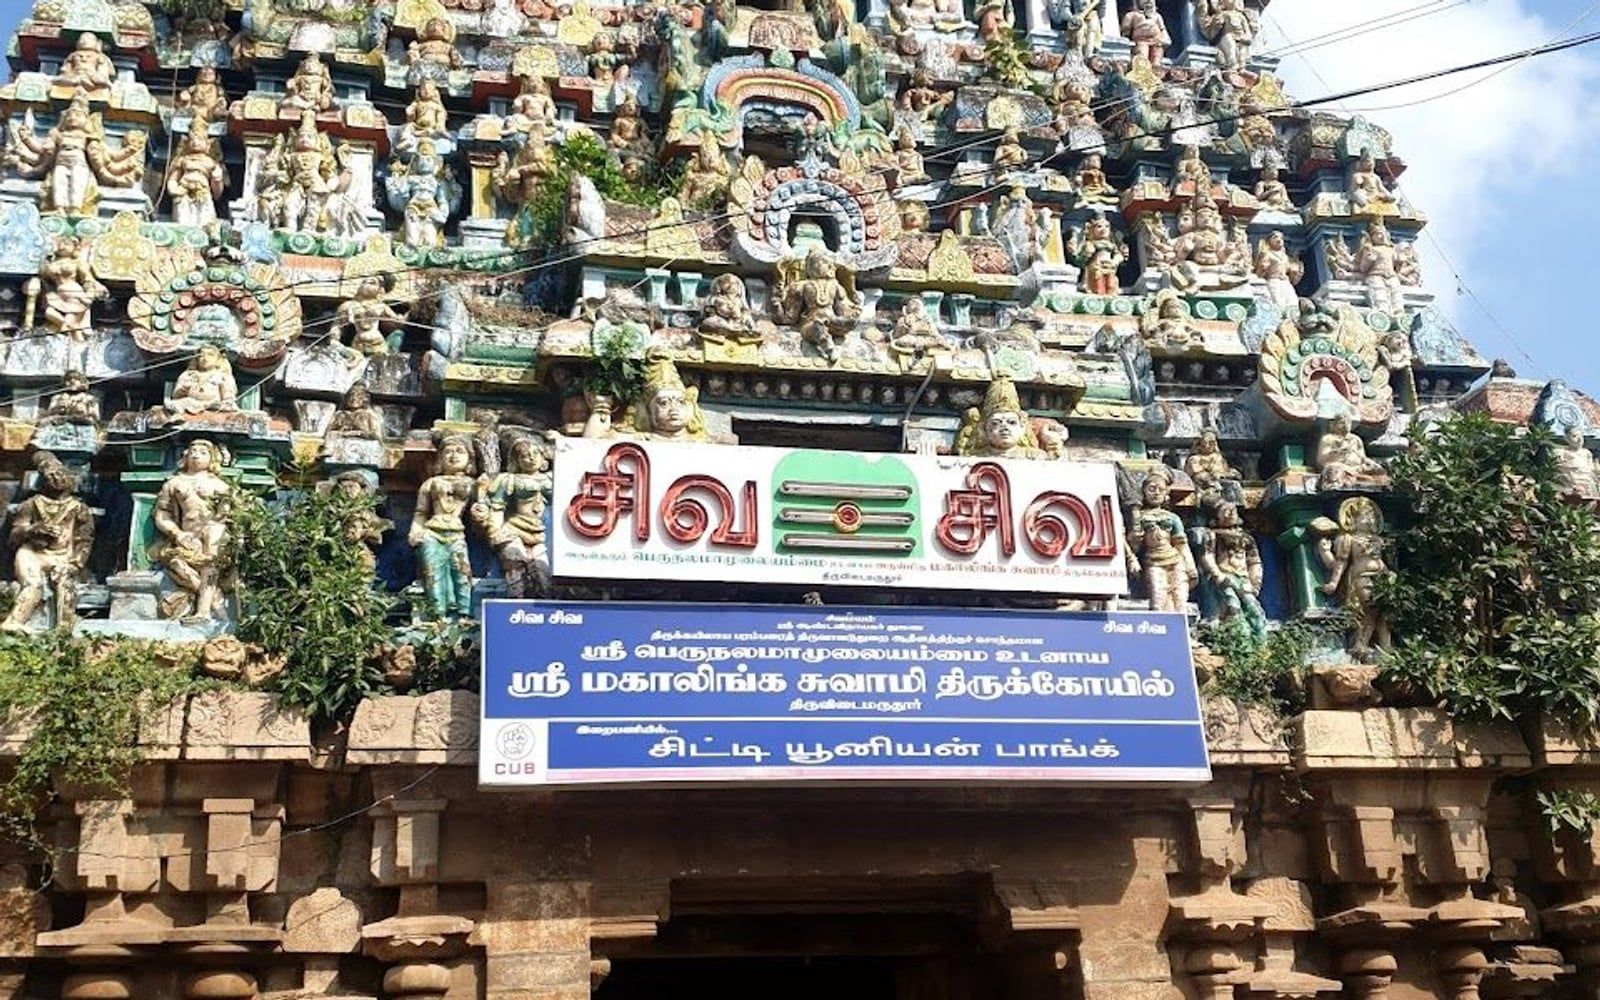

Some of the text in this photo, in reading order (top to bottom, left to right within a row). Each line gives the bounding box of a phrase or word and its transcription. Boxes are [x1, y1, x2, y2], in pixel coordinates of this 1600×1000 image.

[567, 441, 758, 547] சிவ
[936, 461, 1118, 560] சிவ
[930, 561, 1007, 573] மகாலிங்க
[1010, 564, 1061, 575] சுவாமி
[509, 610, 584, 625] சிவ சிவ
[1103, 621, 1167, 635] சிவ சிவ
[634, 643, 987, 662] பெருநலமாமுலையம்மை
[995, 648, 1110, 665] உடனாய
[582, 663, 788, 694] மகாலிங்க
[796, 666, 928, 695] சுவாமி
[935, 666, 1175, 699] திருக்கோயில்
[789, 698, 923, 712] திருவிடைமருதூர்
[648, 736, 1120, 763] சிட்டி யூனியன் பாங்க்
[495, 762, 535, 775] CUB
